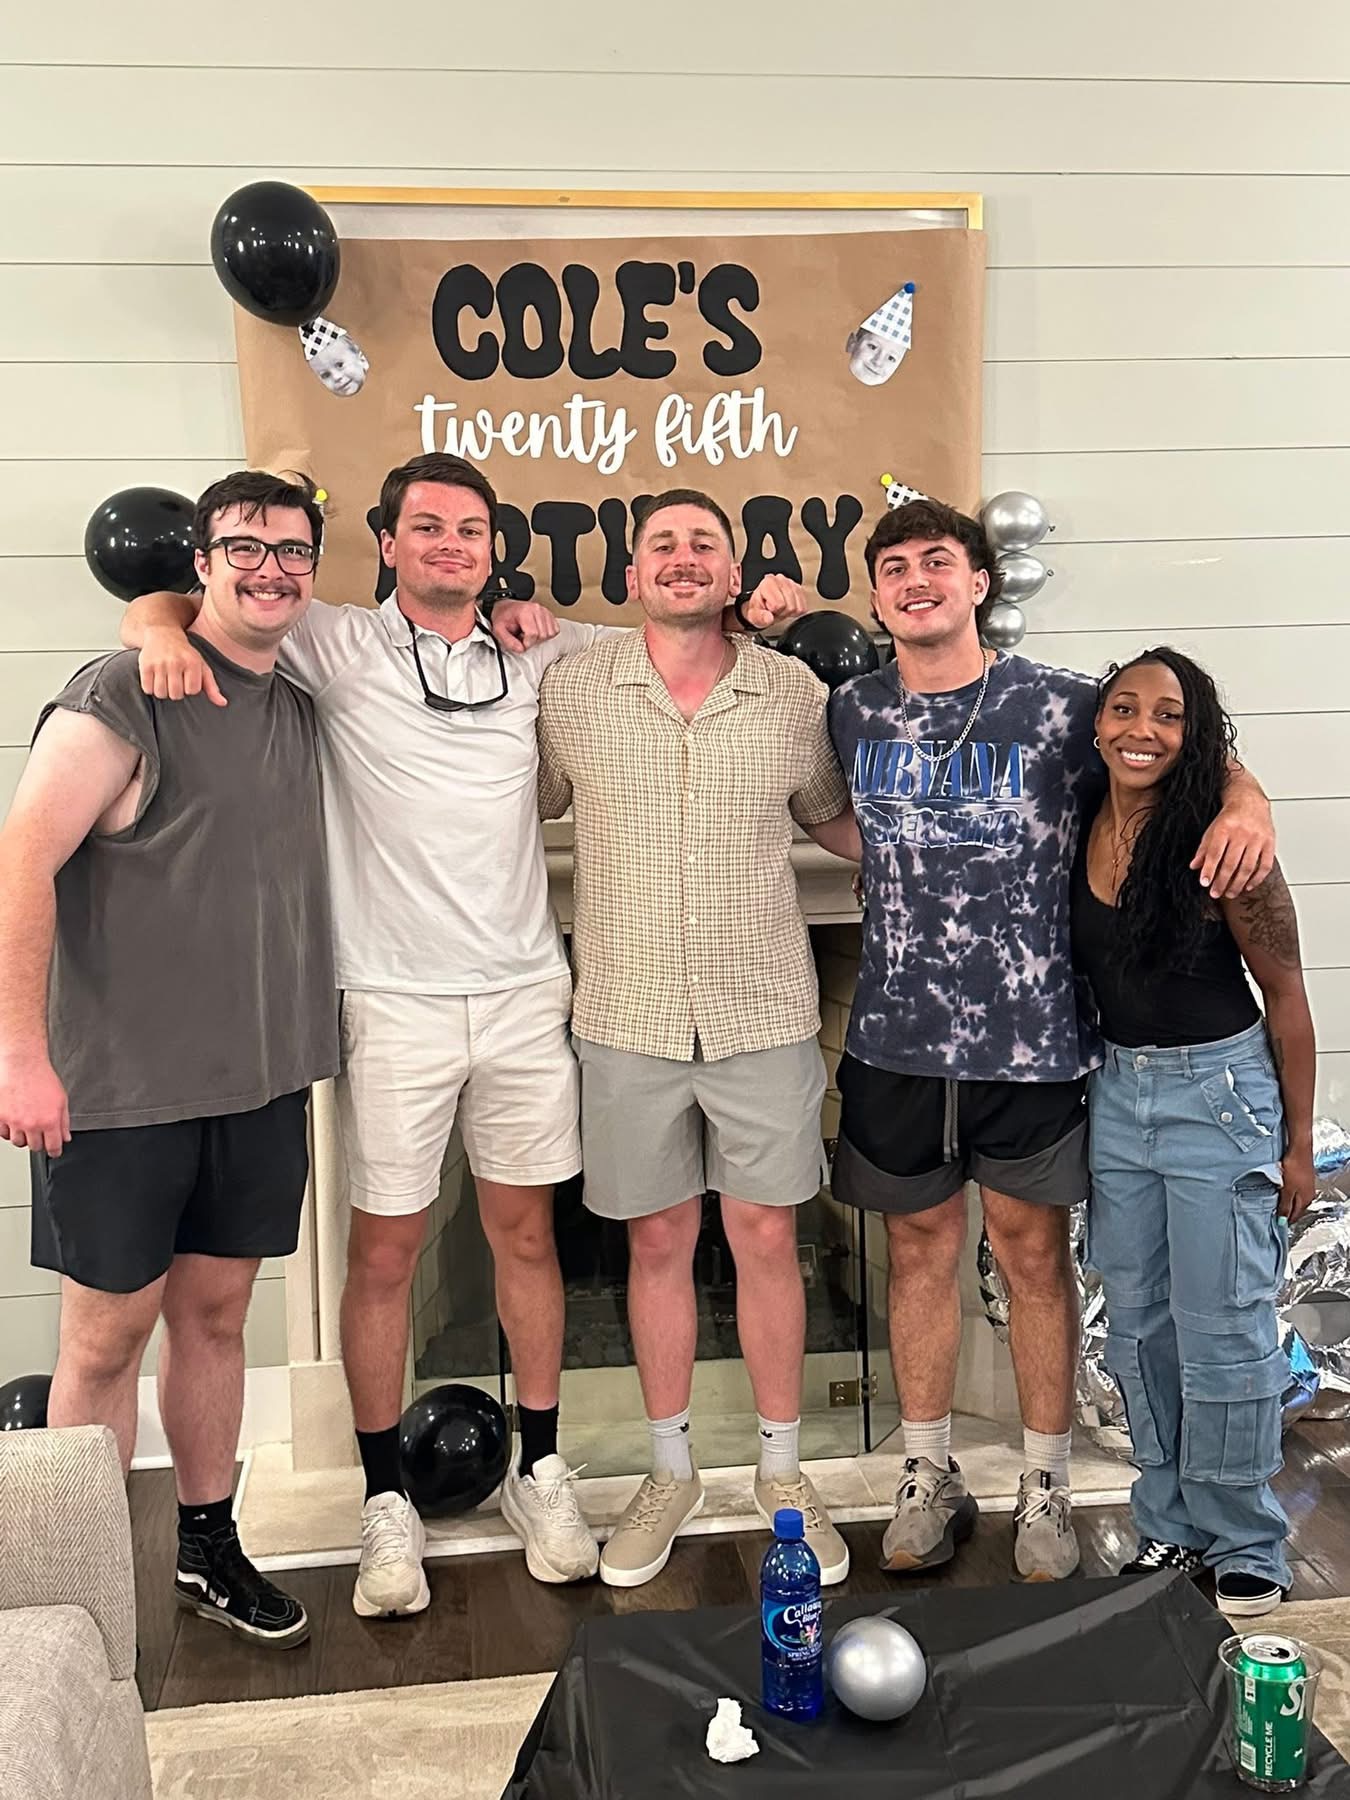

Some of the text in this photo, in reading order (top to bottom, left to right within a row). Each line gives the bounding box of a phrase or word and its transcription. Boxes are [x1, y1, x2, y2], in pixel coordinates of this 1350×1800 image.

[432, 260, 762, 381] COLE'S
[413, 386, 799, 475] twenty fifth
[366, 494, 864, 606] RTHAY
[852, 739, 1024, 799] NIRVANA
[1264, 1720, 1273, 1777] RECYCLE ME
